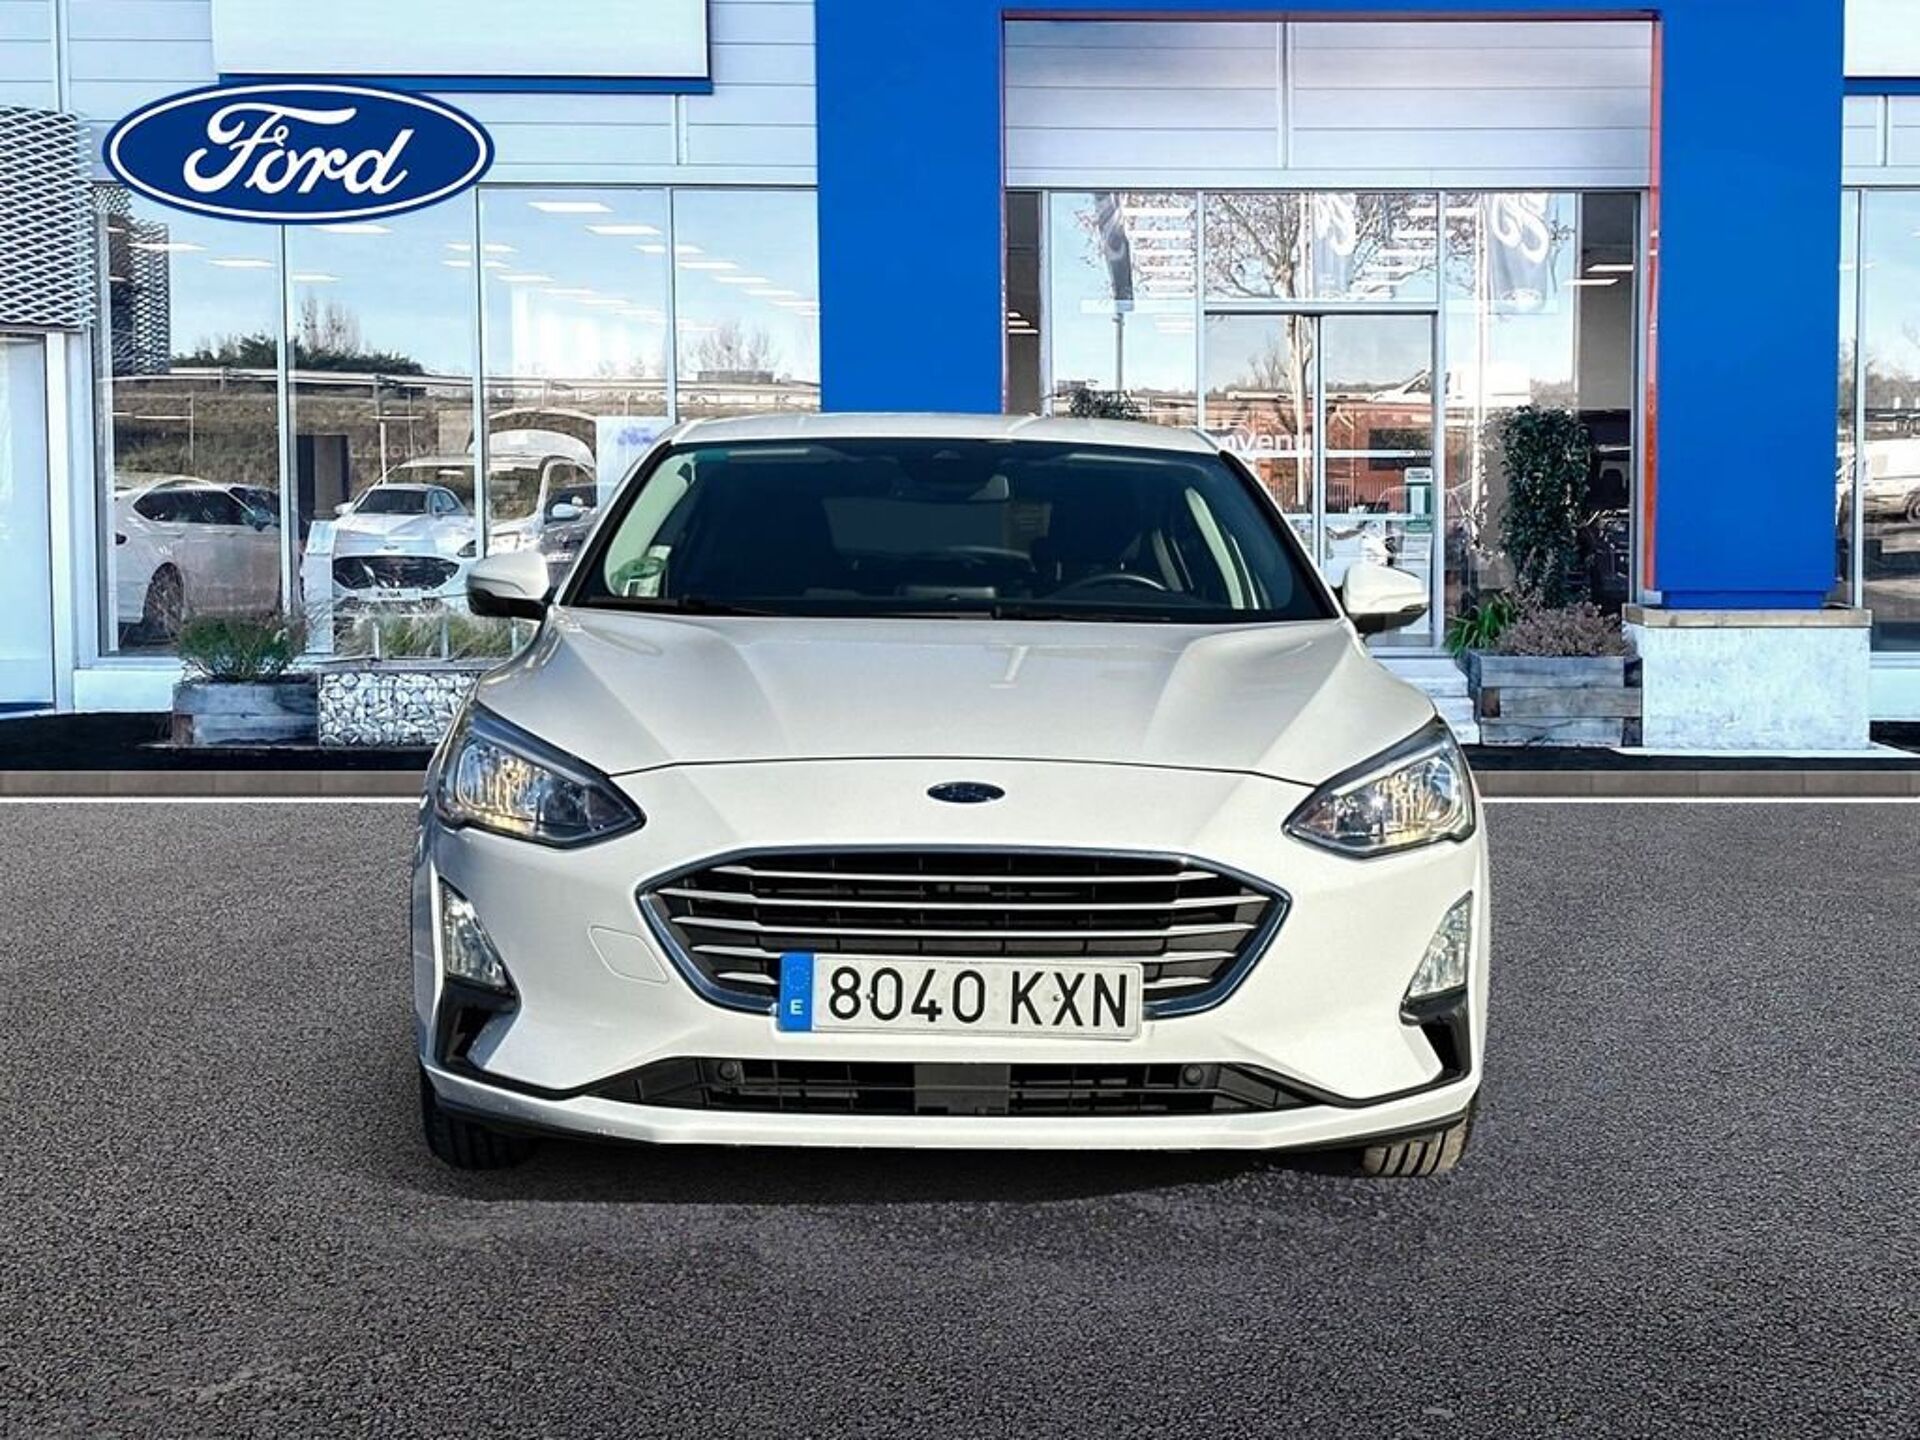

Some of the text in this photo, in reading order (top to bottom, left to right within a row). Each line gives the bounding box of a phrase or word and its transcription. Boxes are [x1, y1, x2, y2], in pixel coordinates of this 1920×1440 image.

[183, 102, 415, 195] Ford
[790, 999, 803, 1015] E
[828, 965, 1128, 1028] 8040 KXN
